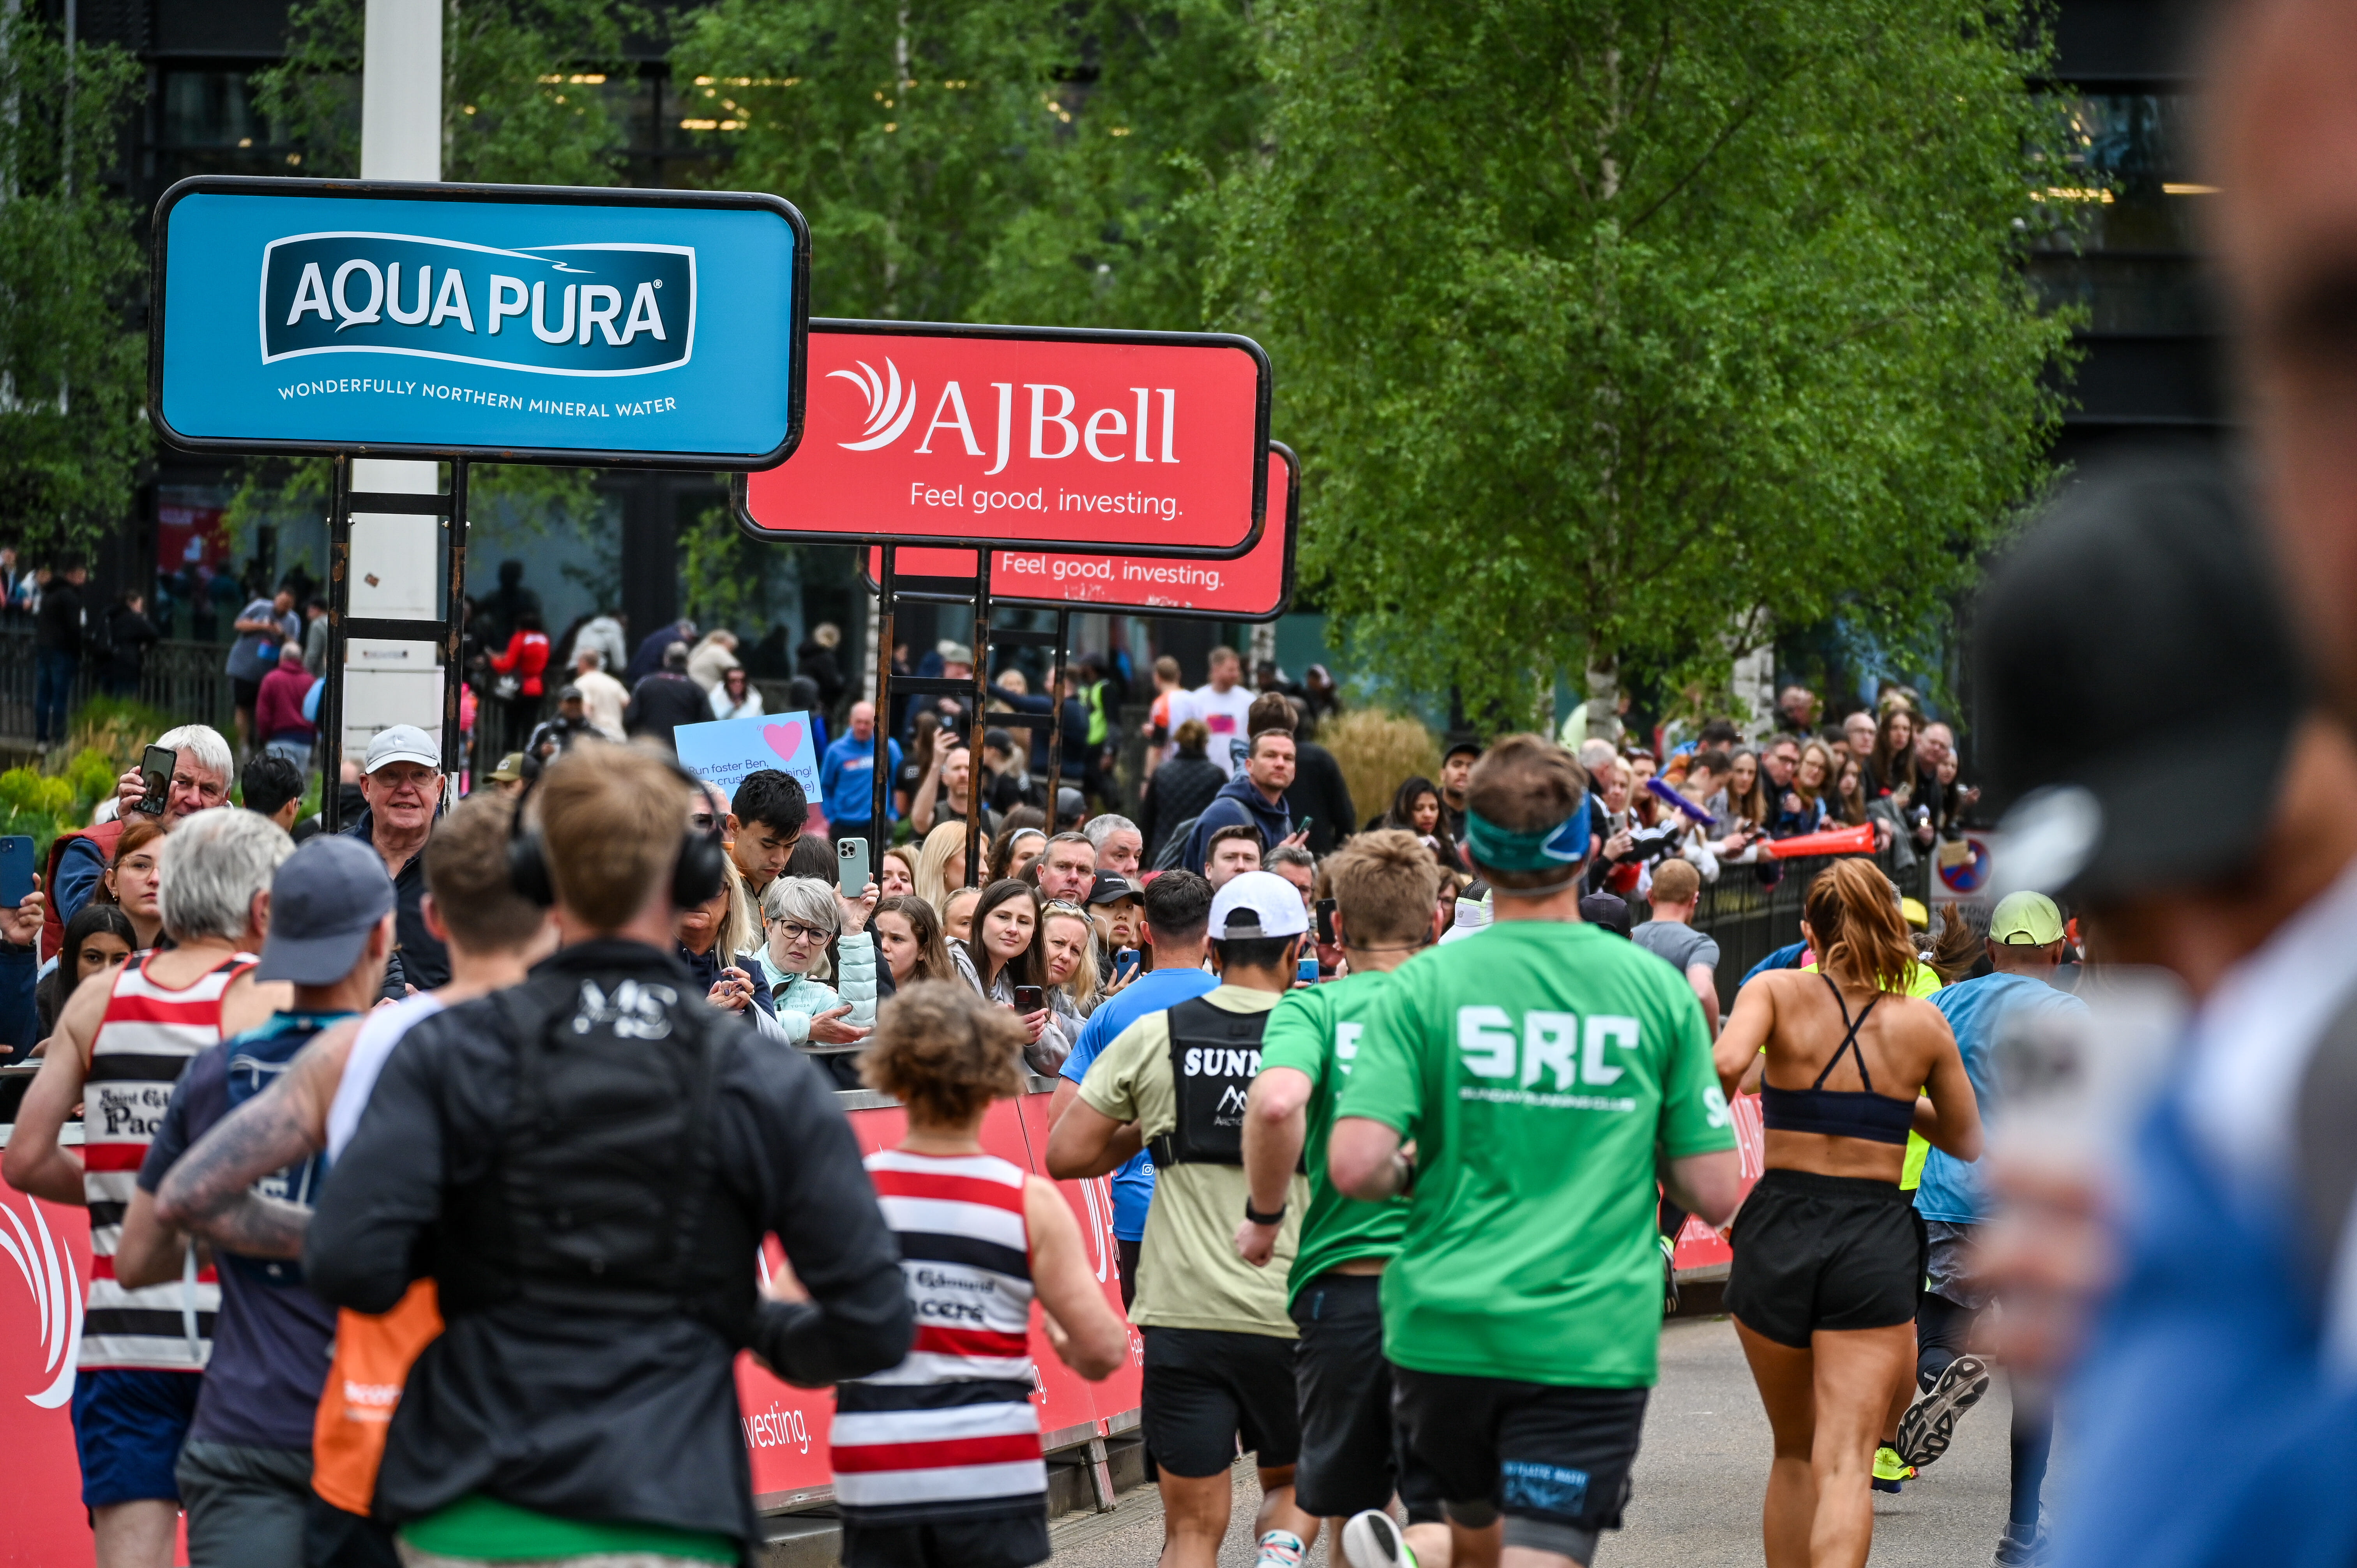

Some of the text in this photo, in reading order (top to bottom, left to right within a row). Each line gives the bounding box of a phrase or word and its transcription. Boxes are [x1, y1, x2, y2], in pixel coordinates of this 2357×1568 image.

[286, 259, 475, 332] AQUA
[278, 378, 676, 417] WONDERFULLY NORTHERN MINERAL WATER
[911, 482, 1183, 521] Feel good, investing.
[1002, 553, 1225, 591] Feel good, investing.
[689, 759, 769, 775] Run faster Ben,
[1457, 1005, 1640, 1091] SRC
